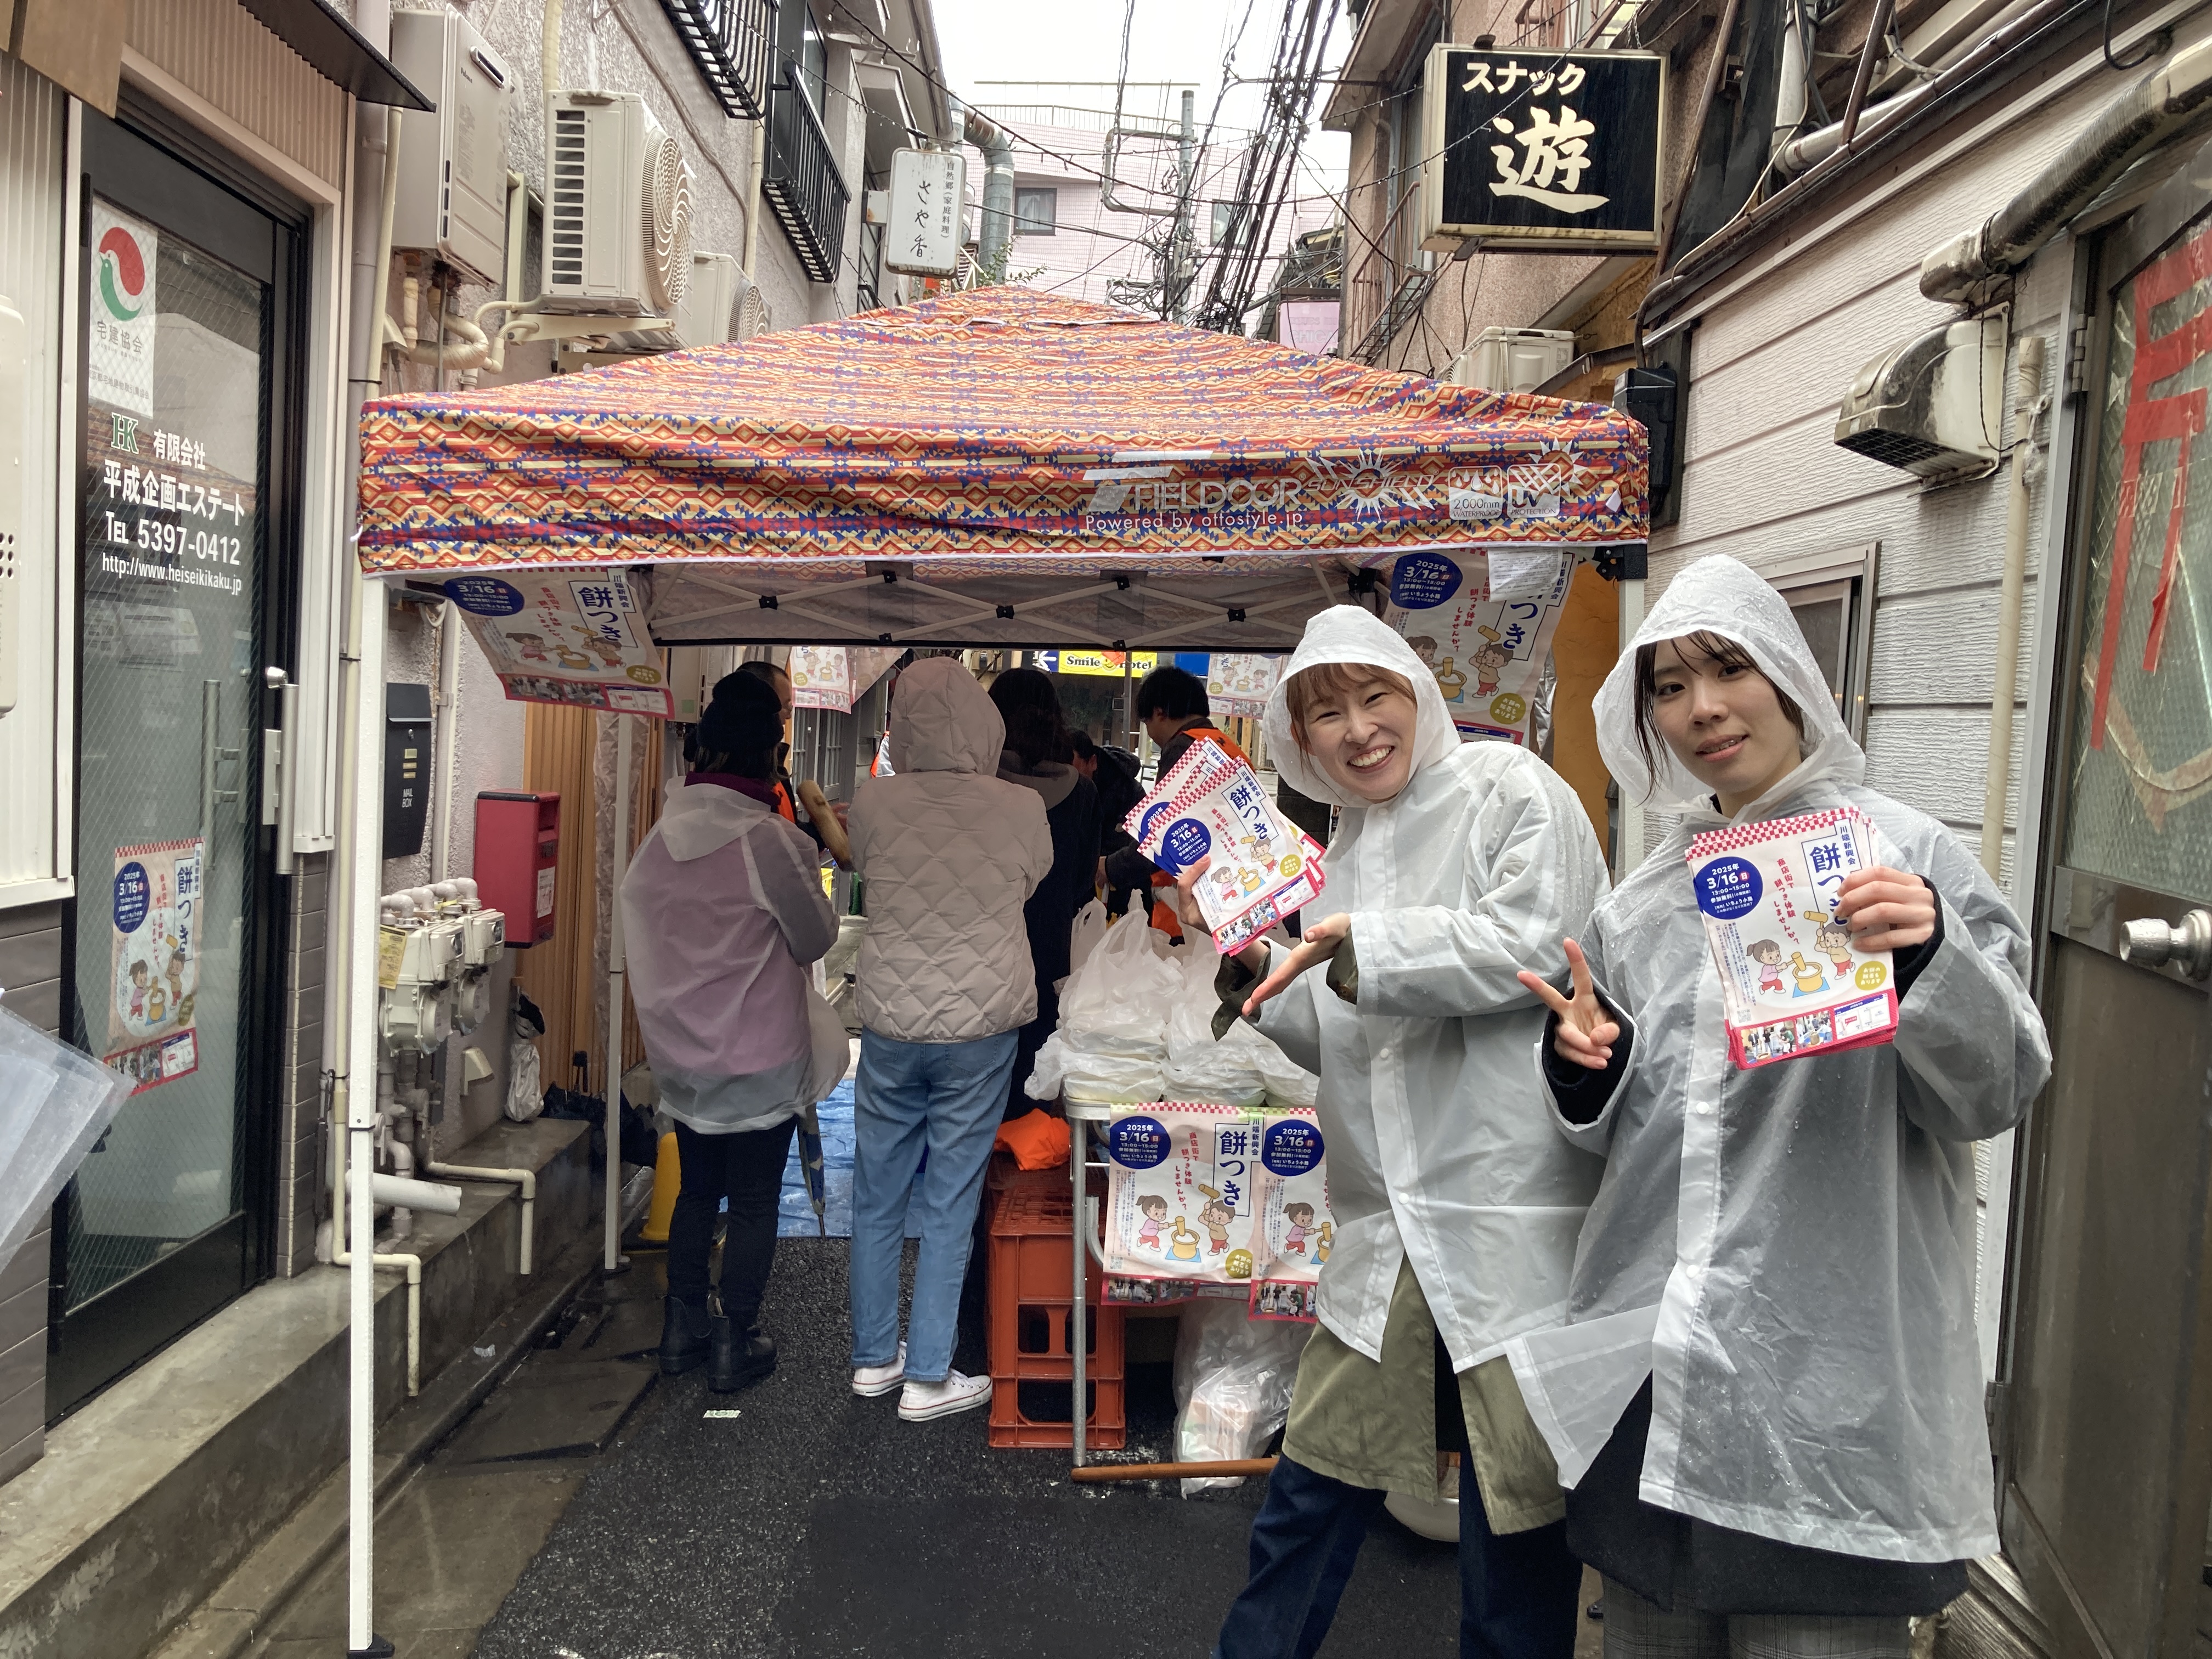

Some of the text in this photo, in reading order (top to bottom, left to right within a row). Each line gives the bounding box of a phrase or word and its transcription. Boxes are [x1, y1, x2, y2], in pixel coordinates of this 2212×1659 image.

[1463, 60, 1585, 96] スナック
[1489, 106, 1610, 213] 遊
[97, 320, 143, 354] 宅建協会
[154, 428, 206, 470] 有限会社
[104, 459, 245, 526] 平成企画エステート
[1135, 478, 1302, 510] FIELDOOR
[1454, 499, 1499, 511] 2,000mm
[1086, 510, 1302, 531] Powered by ottostyle.jp
[138, 518, 241, 565] 5397-0412
[103, 552, 241, 596] http://www.heiseikikaku.jp
[1404, 566, 1438, 579] 3/16
[1416, 560, 1448, 572] 2025年
[458, 585, 495, 593] 3/16
[578, 587, 622, 641] 餅つき
[1503, 595, 1543, 649] つき
[1066, 656, 1100, 666] Smile
[402, 798, 412, 808] BOX
[403, 788, 413, 797] MAIL
[1230, 785, 1268, 840] 餅つき
[1170, 830, 1192, 848] 3/16
[1171, 822, 1189, 837] 2025年
[1840, 826, 1855, 865] 川端新興会
[1706, 872, 1739, 889] 3/16
[1712, 863, 1740, 876] 2025年
[1777, 858, 1795, 888] 商店街で
[119, 881, 138, 895] 3/16
[1725, 896, 1753, 906] いちょう小路
[1774, 878, 1796, 918] 餅つき体験
[177, 866, 193, 953] 餅つき
[1120, 1132, 1149, 1142] 3/16
[1189, 1132, 1199, 1161] 商店街で
[1274, 1136, 1304, 1147] 3/16
[1282, 1128, 1309, 1136] 2025年
[1181, 1148, 1192, 1185] 餅つき体験
[1220, 1131, 1247, 1206] 餅つき
